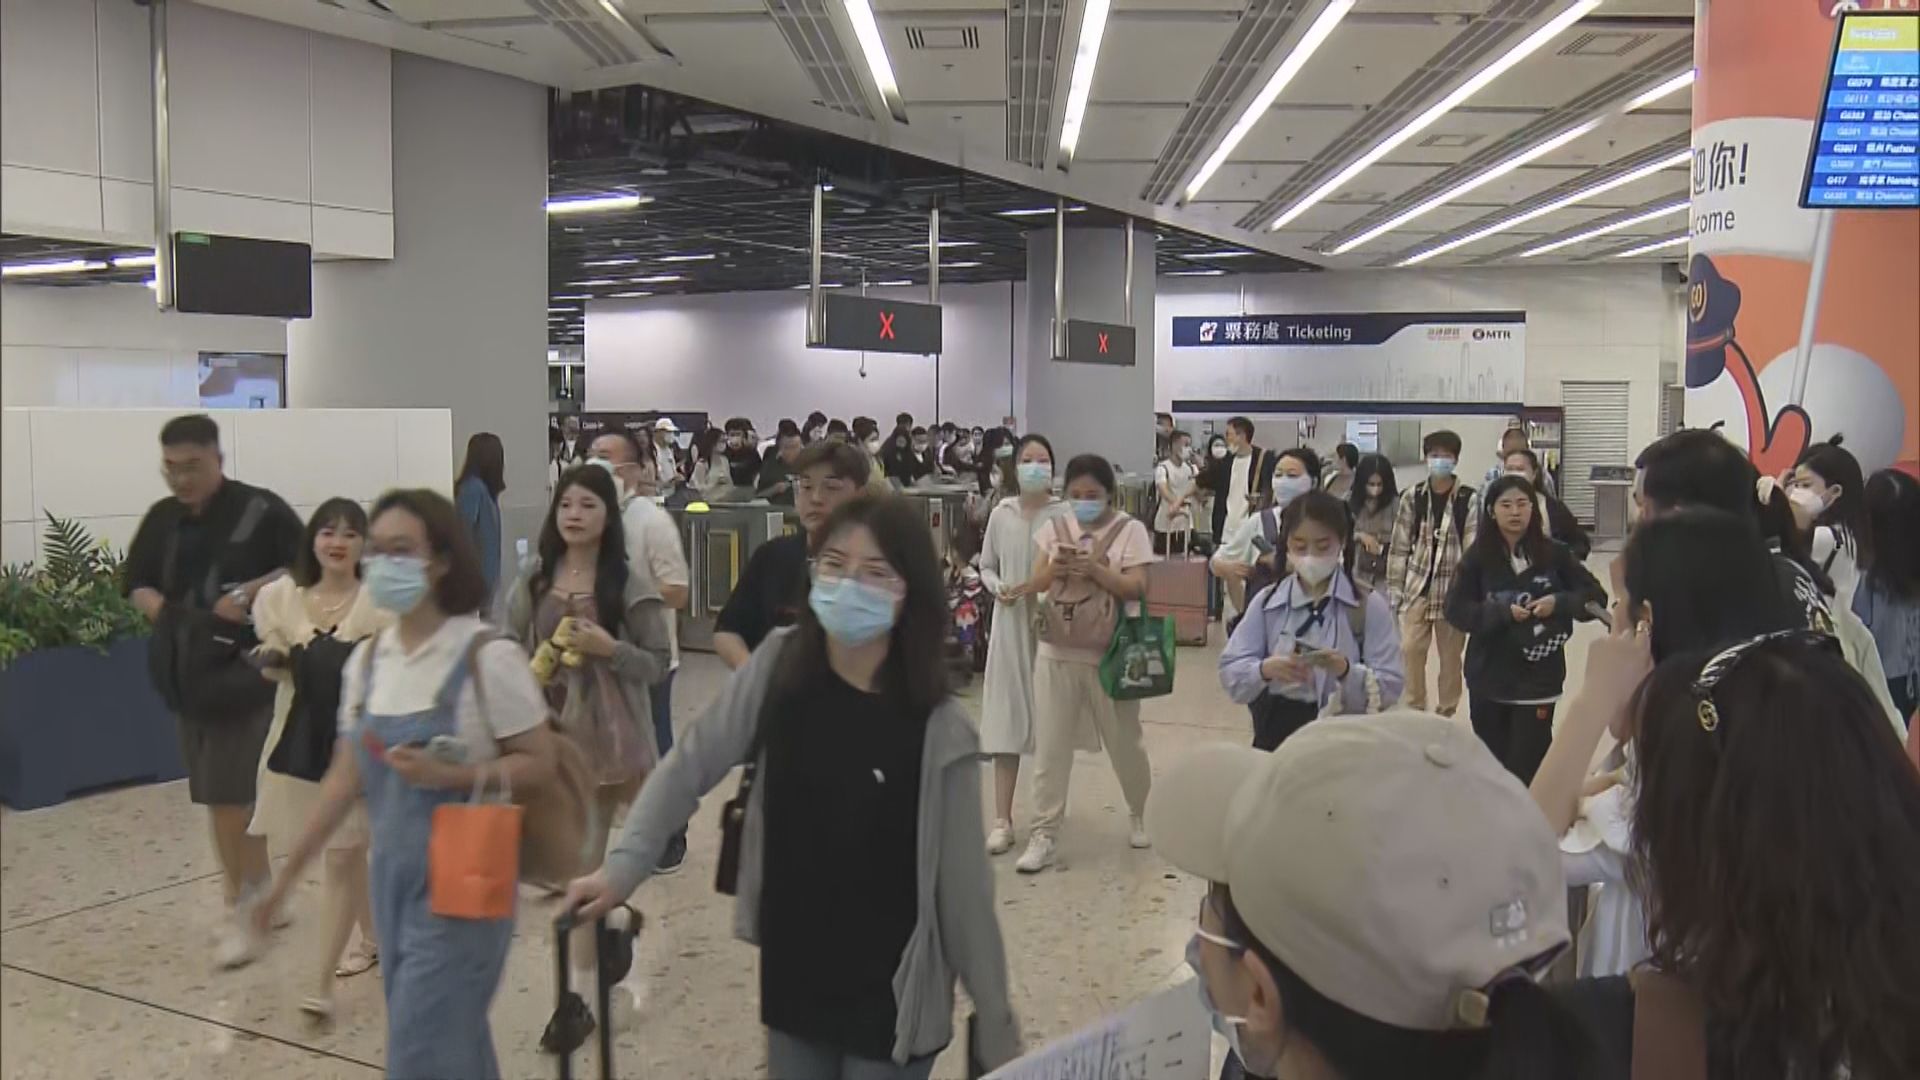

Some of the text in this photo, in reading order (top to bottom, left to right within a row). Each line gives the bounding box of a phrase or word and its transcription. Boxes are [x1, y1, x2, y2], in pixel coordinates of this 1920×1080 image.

[1224, 321, 1352, 341] 票務處 Ticketing
[1486, 330, 1511, 339] MTR
